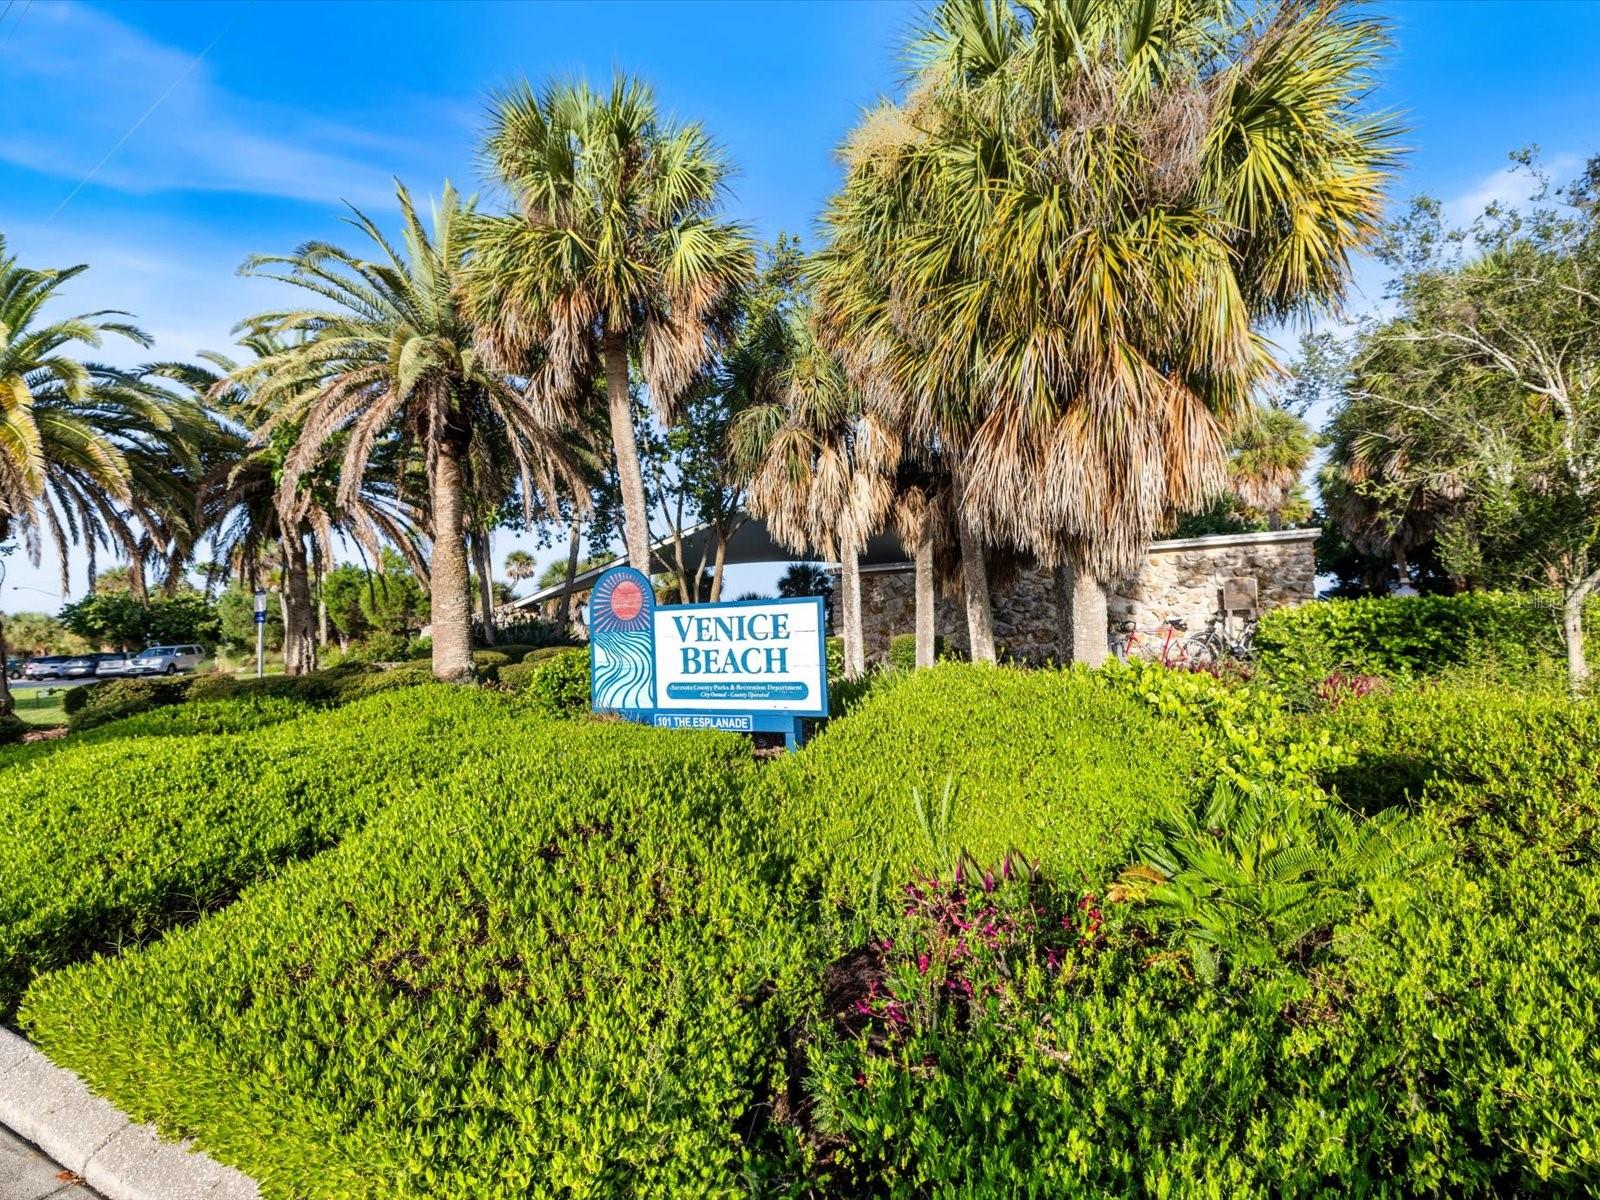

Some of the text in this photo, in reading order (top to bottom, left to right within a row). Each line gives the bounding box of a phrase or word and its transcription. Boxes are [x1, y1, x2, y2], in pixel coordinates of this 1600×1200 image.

[672, 613, 790, 643] VENICE
[680, 647, 790, 675] BEACH
[657, 716, 748, 729] 101 THE ESPLANADE
